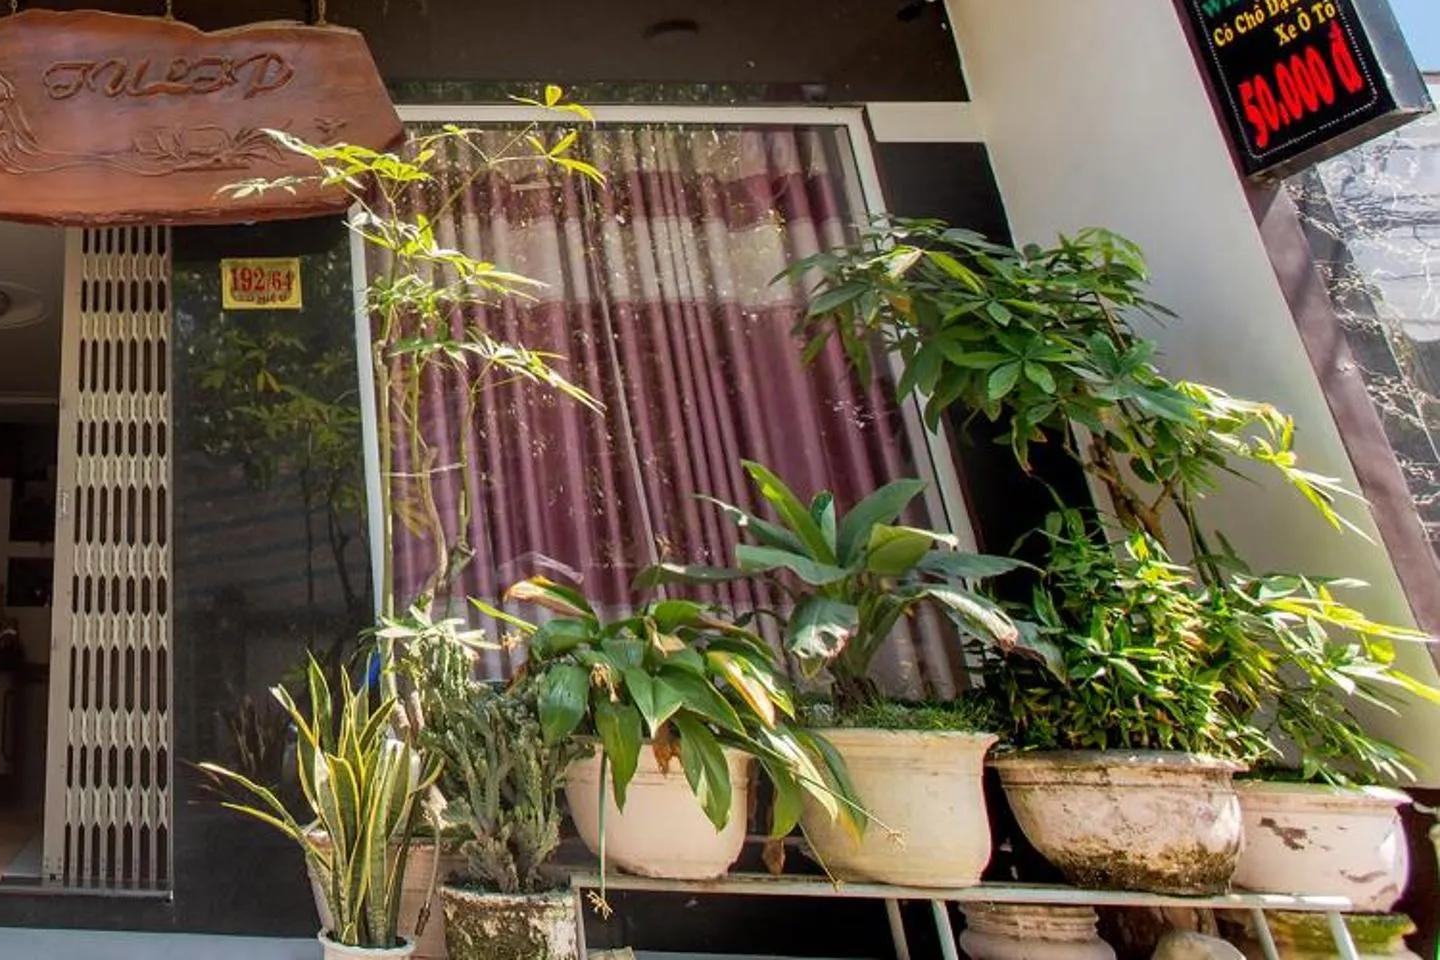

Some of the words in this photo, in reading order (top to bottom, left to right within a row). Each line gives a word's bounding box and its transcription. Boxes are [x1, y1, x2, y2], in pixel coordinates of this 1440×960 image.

[1273, 22, 1299, 47] Xe
[1297, 6, 1311, 32] Ô
[1238, 45, 1335, 148] 50.000
